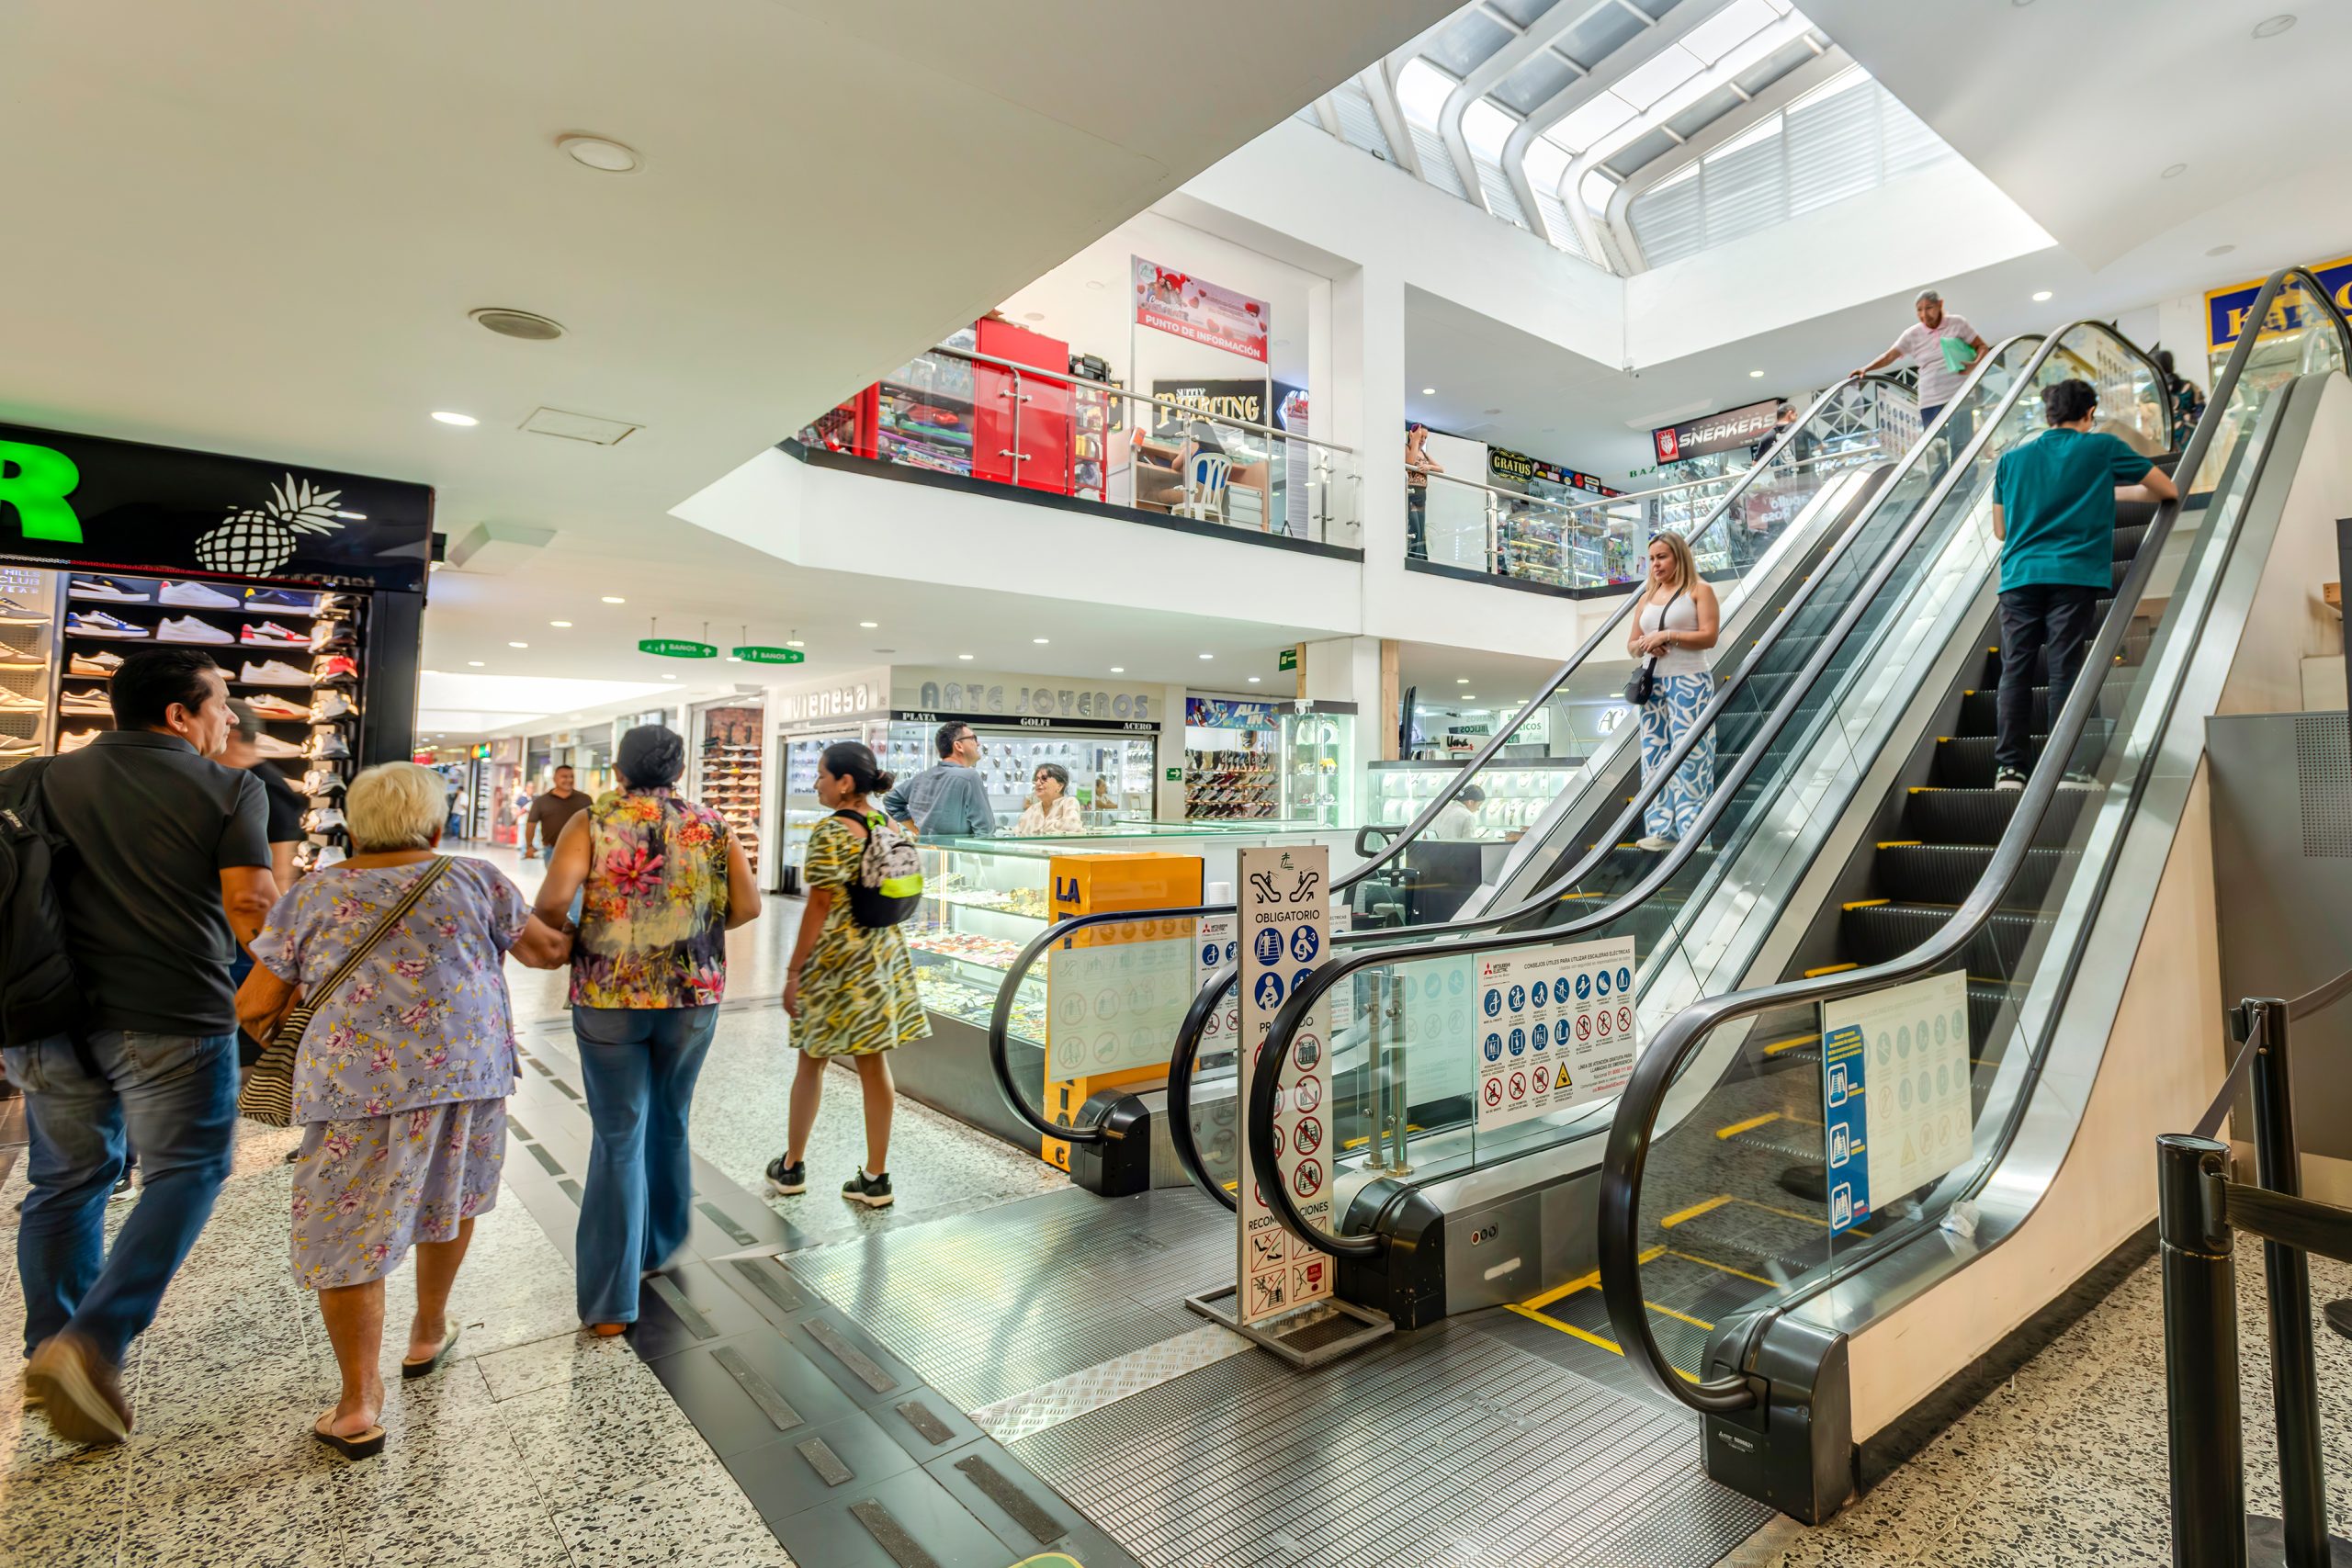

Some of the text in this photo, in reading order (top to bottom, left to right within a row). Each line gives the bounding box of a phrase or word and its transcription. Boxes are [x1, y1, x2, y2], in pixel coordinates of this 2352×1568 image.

[1145, 314, 1261, 357] PUNTO DE INFORMACIÓN
[1155, 392, 1260, 429] PIERCING
[1679, 412, 1777, 448] SNEAKERS
[1494, 456, 1531, 476] GRATUS
[0, 440, 84, 544] R
[4, 569, 41, 578] HILLS
[920, 682, 1148, 719] ARTE JOYEROS
[902, 712, 936, 722] PLATA
[1233, 704, 1261, 717] ALL
[1247, 714, 1264, 726] IN
[1123, 722, 1152, 731] ACERO
[1057, 876, 1080, 904] LA
[1255, 909, 1320, 923] OBLIGATORIO
[1308, 932, 1316, 942] -3
[1524, 961, 1545, 970] CONSEJOS
[1588, 952, 1609, 960] ESCALERAS
[1249, 1201, 1329, 1232] RECOMCIONES
